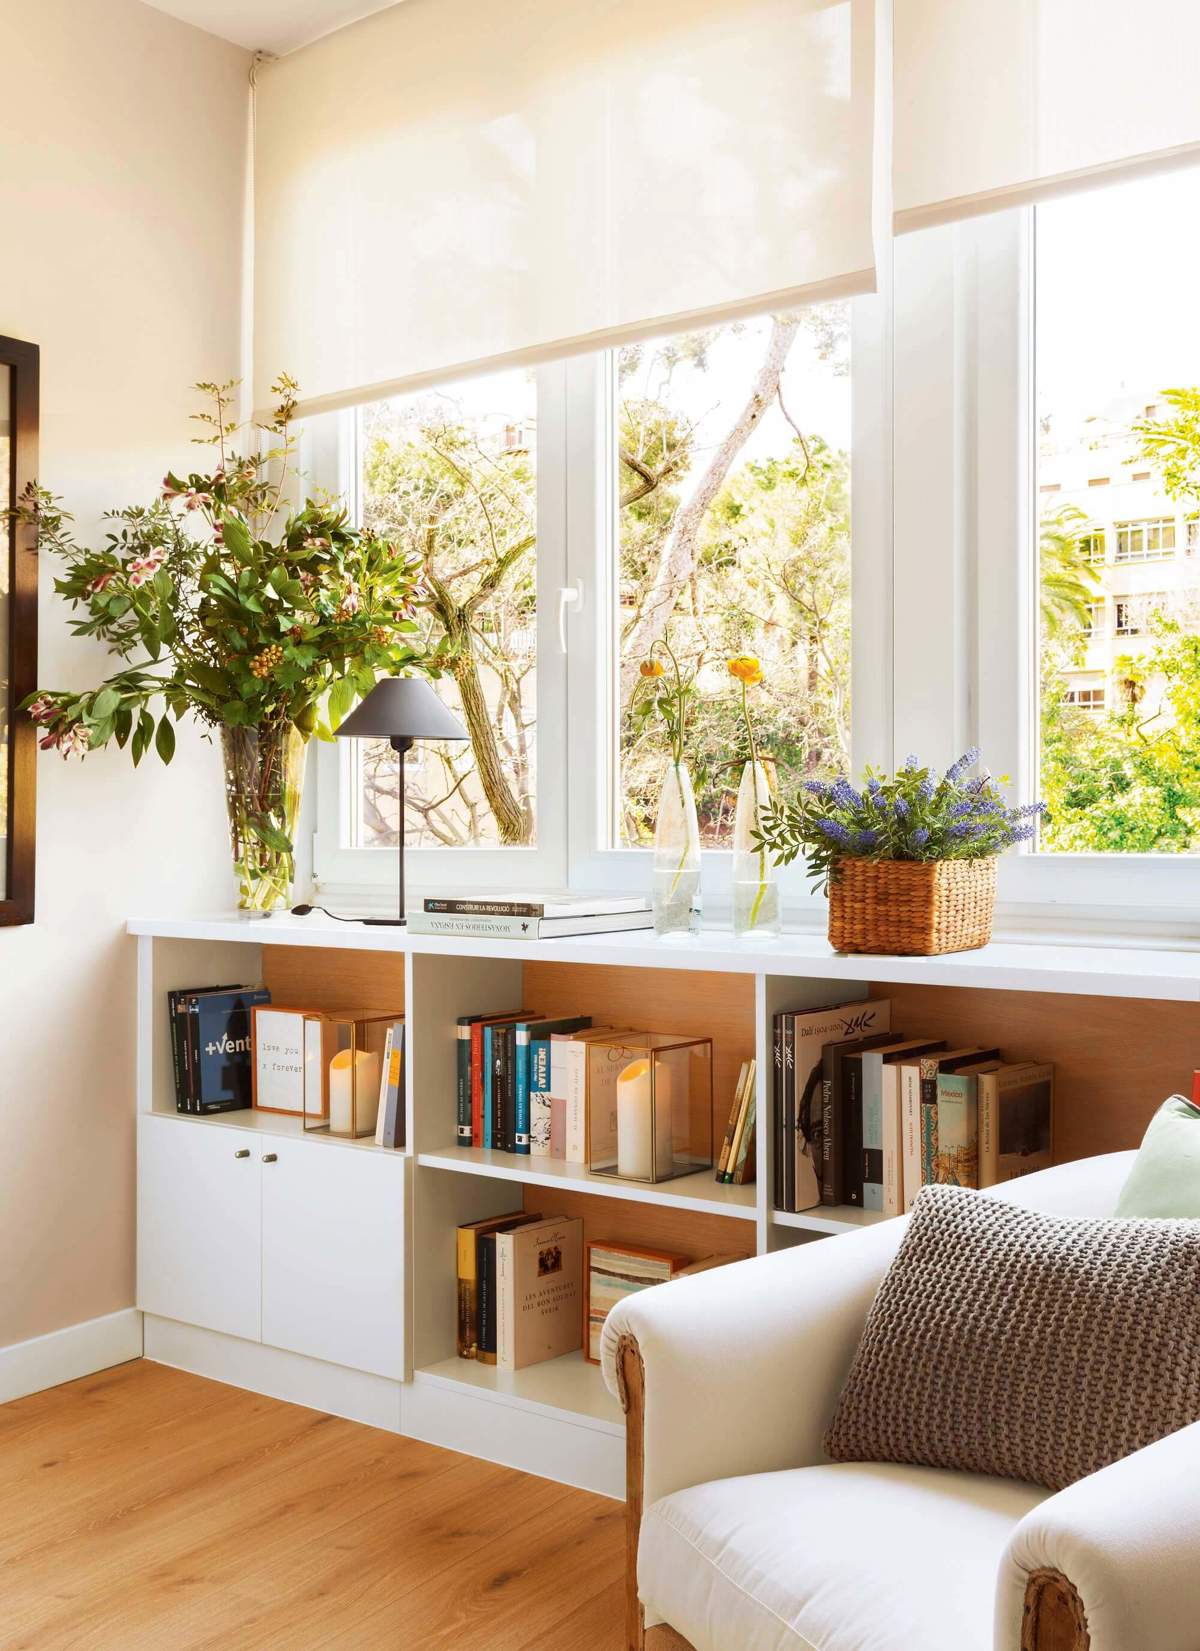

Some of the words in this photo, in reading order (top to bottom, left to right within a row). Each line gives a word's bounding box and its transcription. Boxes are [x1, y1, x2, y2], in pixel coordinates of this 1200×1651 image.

[263, 1043, 280, 1052] love
[284, 1047, 299, 1056] you
[272, 1063, 303, 1073] forever
